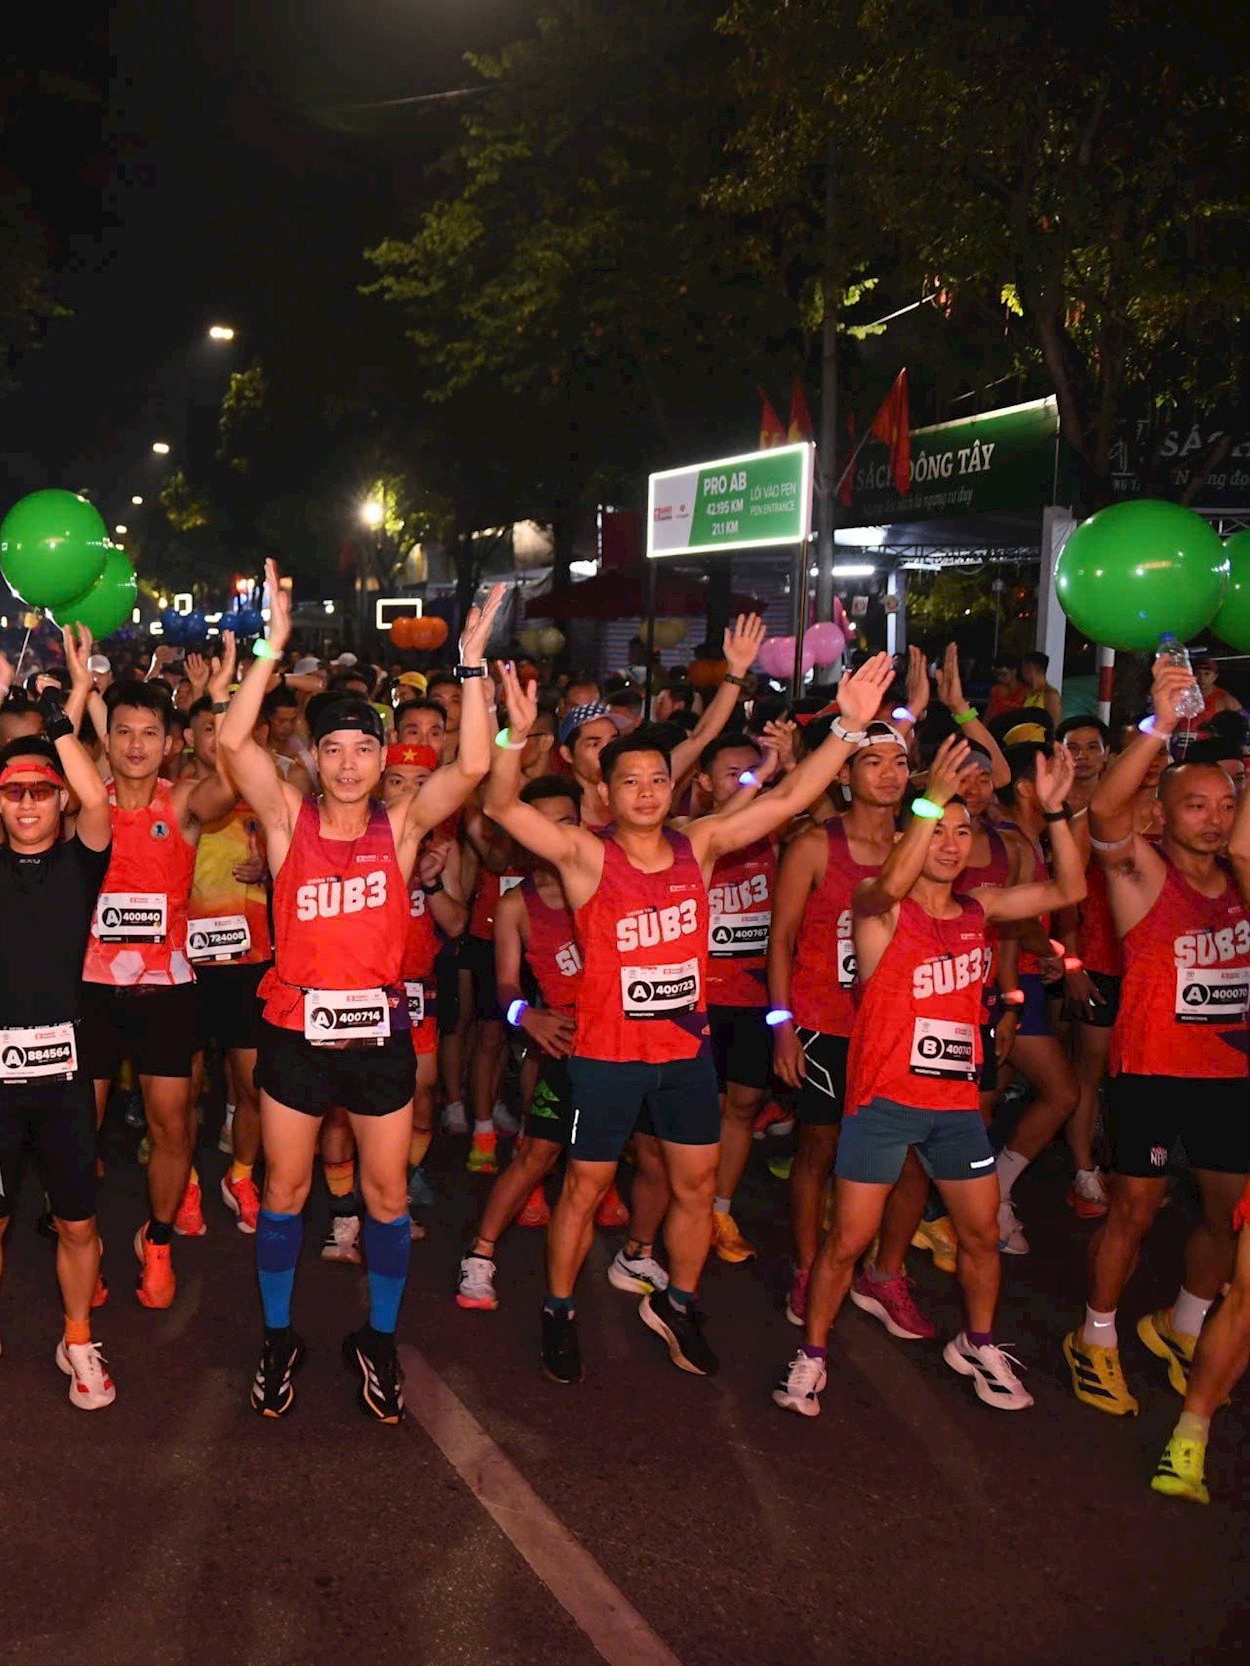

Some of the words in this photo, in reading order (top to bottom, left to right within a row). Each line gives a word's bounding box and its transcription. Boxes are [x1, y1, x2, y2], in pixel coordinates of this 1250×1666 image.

[1158, 423, 1250, 457] SÁ
[957, 439, 995, 475] TÂY
[703, 475, 727, 496] PRO
[729, 472, 747, 492] AB
[780, 481, 796, 496] PEN
[730, 498, 744, 513] KM
[750, 504, 763, 516] PEN
[763, 501, 796, 514] ENTRANCE
[726, 520, 739, 534] KM
[297, 870, 387, 921] SUB3
[709, 873, 769, 914] SUB3
[106, 909, 121, 926] A
[122, 912, 161, 921] 400840
[616, 898, 698, 953] SUB3
[193, 933, 207, 948] A
[209, 931, 245, 943] 724008
[715, 929, 729, 942] A
[735, 928, 768, 939] 400767
[1174, 920, 1250, 968] SUB3
[912, 947, 982, 1000] SUB3
[632, 983, 648, 999] A
[655, 979, 695, 995] 400723
[1185, 986, 1203, 1002] A
[315, 1011, 330, 1028] A
[339, 1010, 381, 1023] 400714
[4, 1048, 23, 1066] A
[27, 1046, 70, 1061] 884564
[922, 1039, 937, 1055] B
